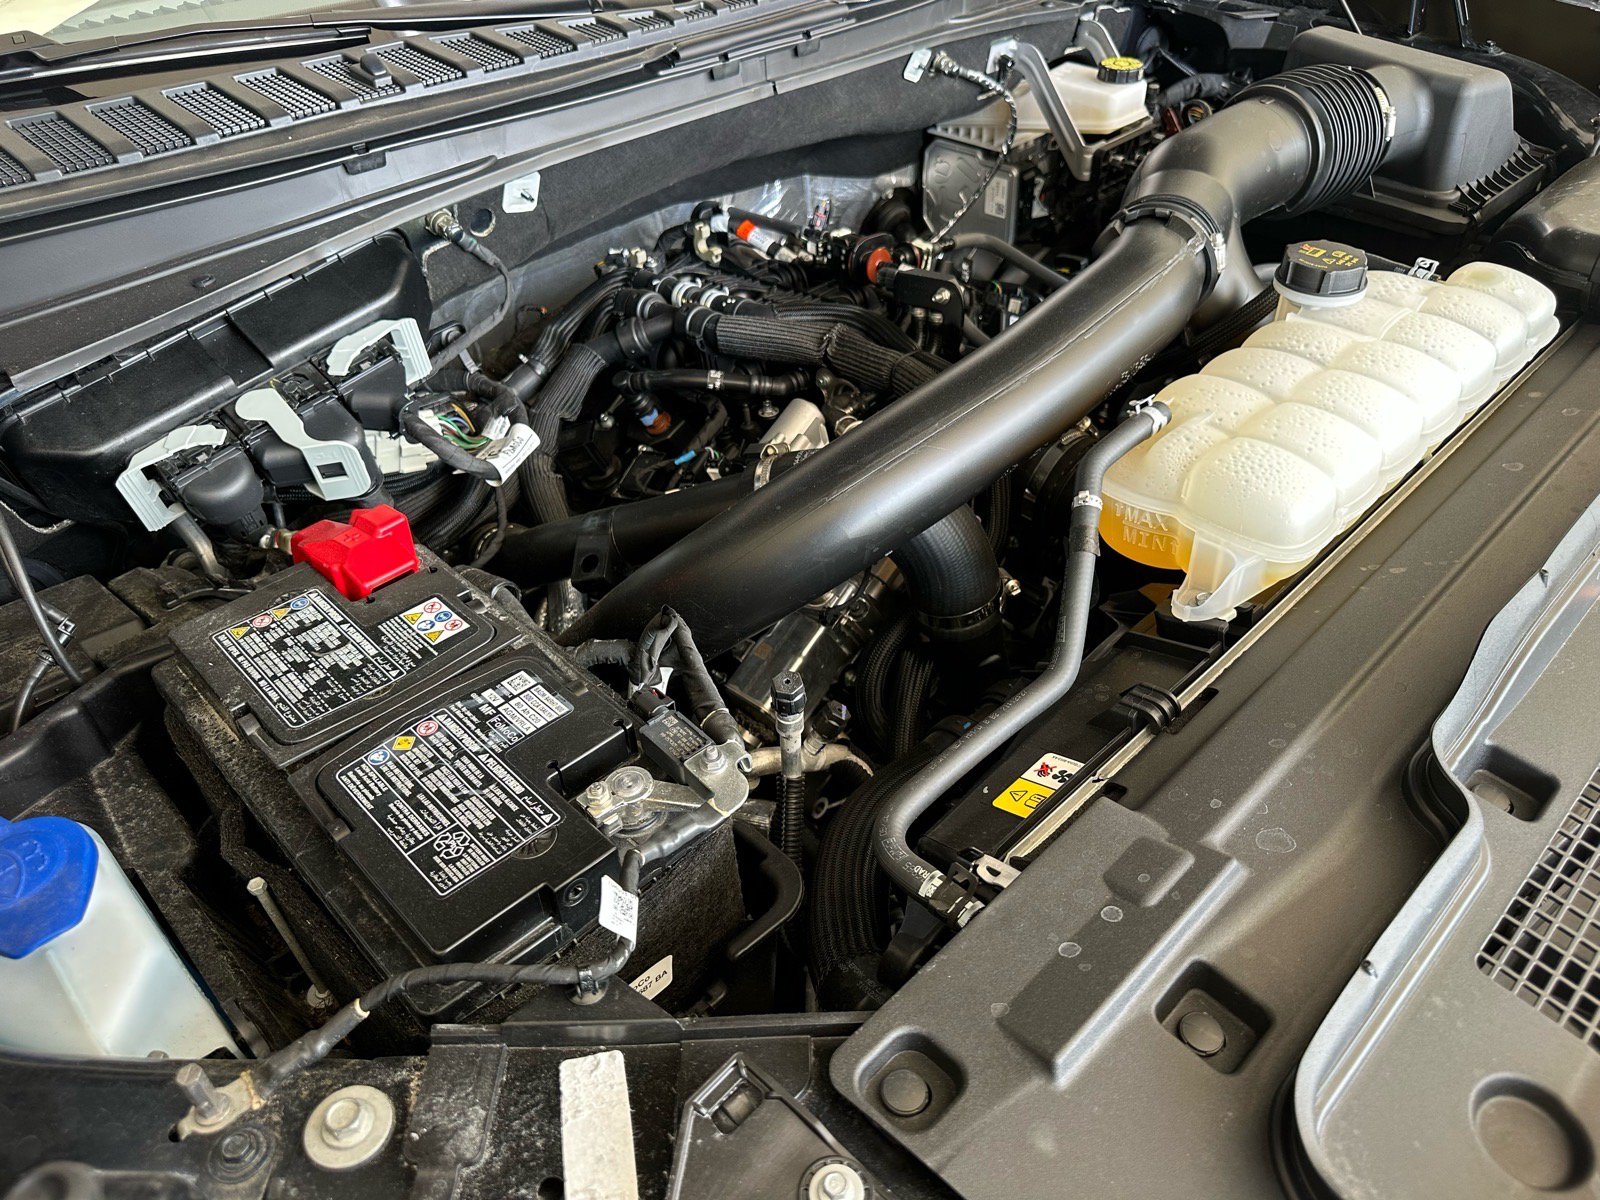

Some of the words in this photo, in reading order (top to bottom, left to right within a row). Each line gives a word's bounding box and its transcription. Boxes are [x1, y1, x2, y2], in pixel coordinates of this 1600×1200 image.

[1124, 506, 1169, 532] MAX
[1123, 526, 1168, 552] MIN
[486, 692, 500, 702] 12V
[478, 702, 497, 717] MF
[500, 706, 532, 731] AGM/VRLA
[520, 707, 531, 715] Ah
[489, 716, 521, 742] FoMoCo
[482, 757, 526, 794] PELIGRO/VENENO
[914, 865, 930, 879] RAD
[655, 970, 668, 983] BA
